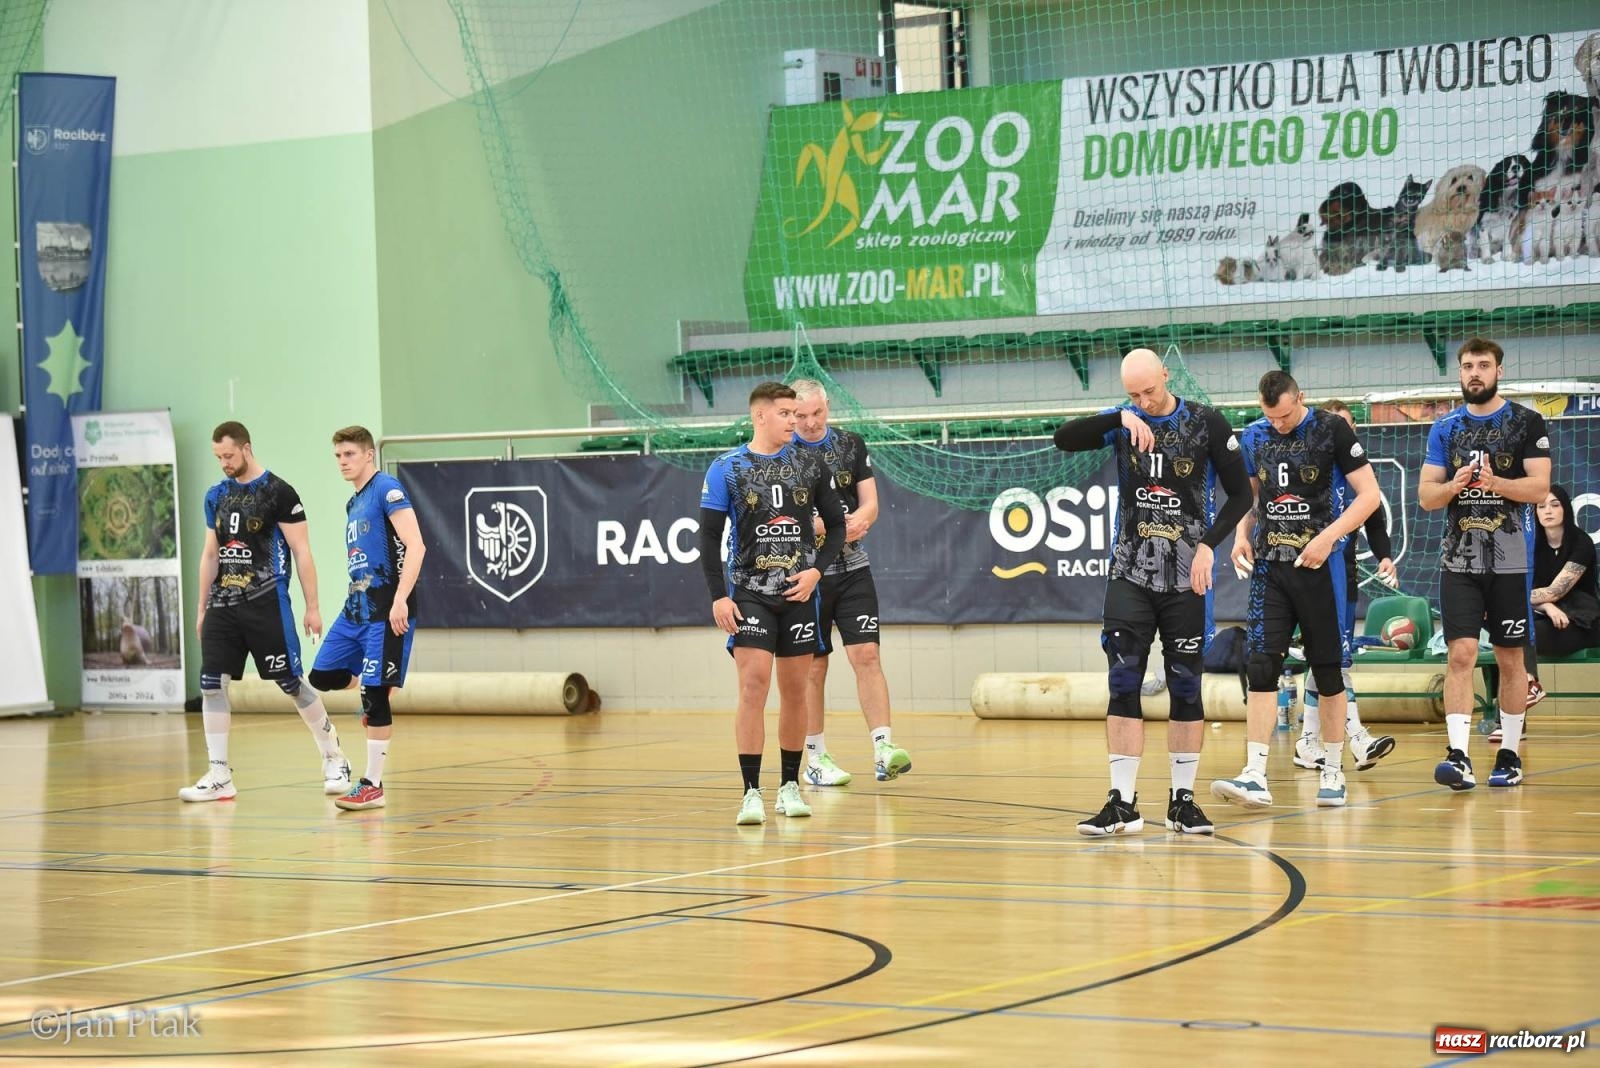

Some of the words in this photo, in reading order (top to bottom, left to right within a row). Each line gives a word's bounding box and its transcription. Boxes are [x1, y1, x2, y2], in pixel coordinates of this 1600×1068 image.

[1086, 61, 1276, 125] WSZYSTKO
[1291, 53, 1361, 106] DLA
[1375, 33, 1553, 98] TWOJEGO
[53, 127, 107, 142] Racibórz
[1082, 115, 1305, 181] DOMOWEGO
[1318, 107, 1399, 161] ZOO
[859, 171, 1022, 230] MAR
[1073, 207, 1136, 228] Dzielimy
[1140, 206, 1163, 227] się
[1167, 204, 1212, 224] naszą
[1214, 197, 1257, 221] pasją
[855, 231, 901, 250] sklep
[908, 228, 1017, 248] zoologiczny
[1064, 236, 1072, 250] i
[1074, 234, 1125, 251] wiedzą
[1130, 231, 1151, 245] od
[1156, 227, 1196, 244] 1989
[1198, 226, 1238, 241] roku.
[773, 262, 1006, 310] WWW.ZOO-MAR.PL
[1148, 452, 1163, 479] 11
[1277, 462, 1289, 487] 6
[771, 484, 783, 509] 0
[1135, 487, 1182, 508] GOLD
[1266, 501, 1310, 514] GOLD
[229, 512, 240, 534] 9
[347, 519, 358, 544] 20
[755, 524, 801, 537] GOLD
[218, 546, 252, 558] GOLD
[348, 553, 368, 568] OLD
